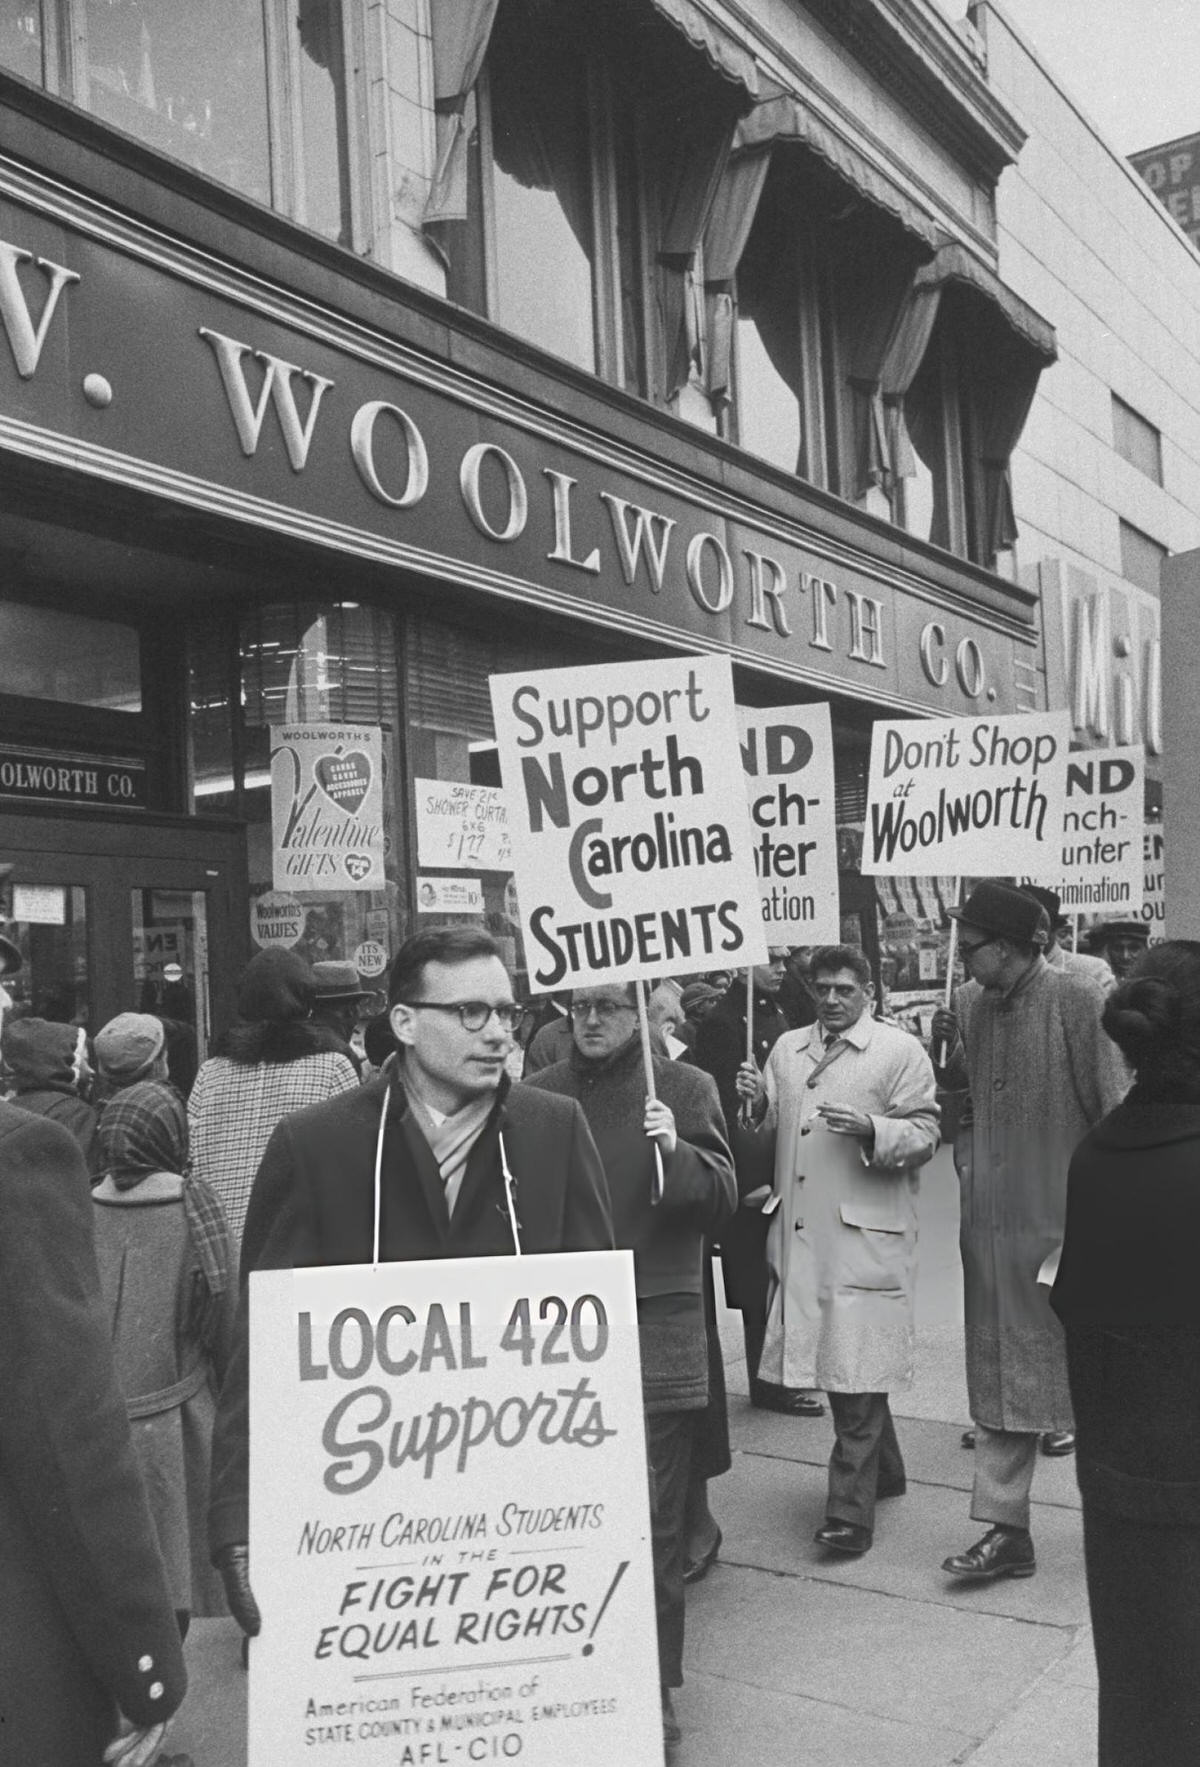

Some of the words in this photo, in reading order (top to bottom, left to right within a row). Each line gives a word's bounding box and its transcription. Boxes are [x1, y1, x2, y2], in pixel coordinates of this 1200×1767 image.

[199, 326, 887, 669] WOOLWORTH
[919, 621, 997, 704] CO.
[511, 669, 711, 748] Support
[883, 728, 961, 779] Don't
[969, 724, 1058, 776] Shop
[107, 774, 137, 798] CO.
[520, 734, 705, 833] North
[748, 783, 821, 828] ch-
[893, 777, 916, 798] at
[871, 776, 1048, 864] Woolworth
[286, 853, 340, 876] GIFTS
[568, 811, 734, 911] Carolina
[752, 832, 817, 878] ter
[256, 922, 298, 939] VALUES
[528, 900, 745, 987] STUDENTS
[298, 1301, 487, 1381] LOCAL
[499, 1294, 609, 1367] 420
[321, 1377, 617, 1496] Supports
[297, 1520, 375, 1556] NORTH
[380, 1512, 487, 1548] CAROLINA
[496, 1502, 605, 1537] STUDENTS
[422, 1554, 443, 1567] IN
[458, 1548, 498, 1564] THE
[338, 1571, 470, 1616] FIGHT
[484, 1563, 566, 1601] FOR
[314, 1616, 439, 1660] EQUAL
[304, 1696, 400, 1719] American
[410, 1681, 513, 1709] Federation
[518, 1675, 539, 1698] of
[358, 1718, 421, 1741] COUNTY
[440, 1708, 525, 1732] MUNICIPAL
[532, 1698, 618, 1721] EMPLOYEES
